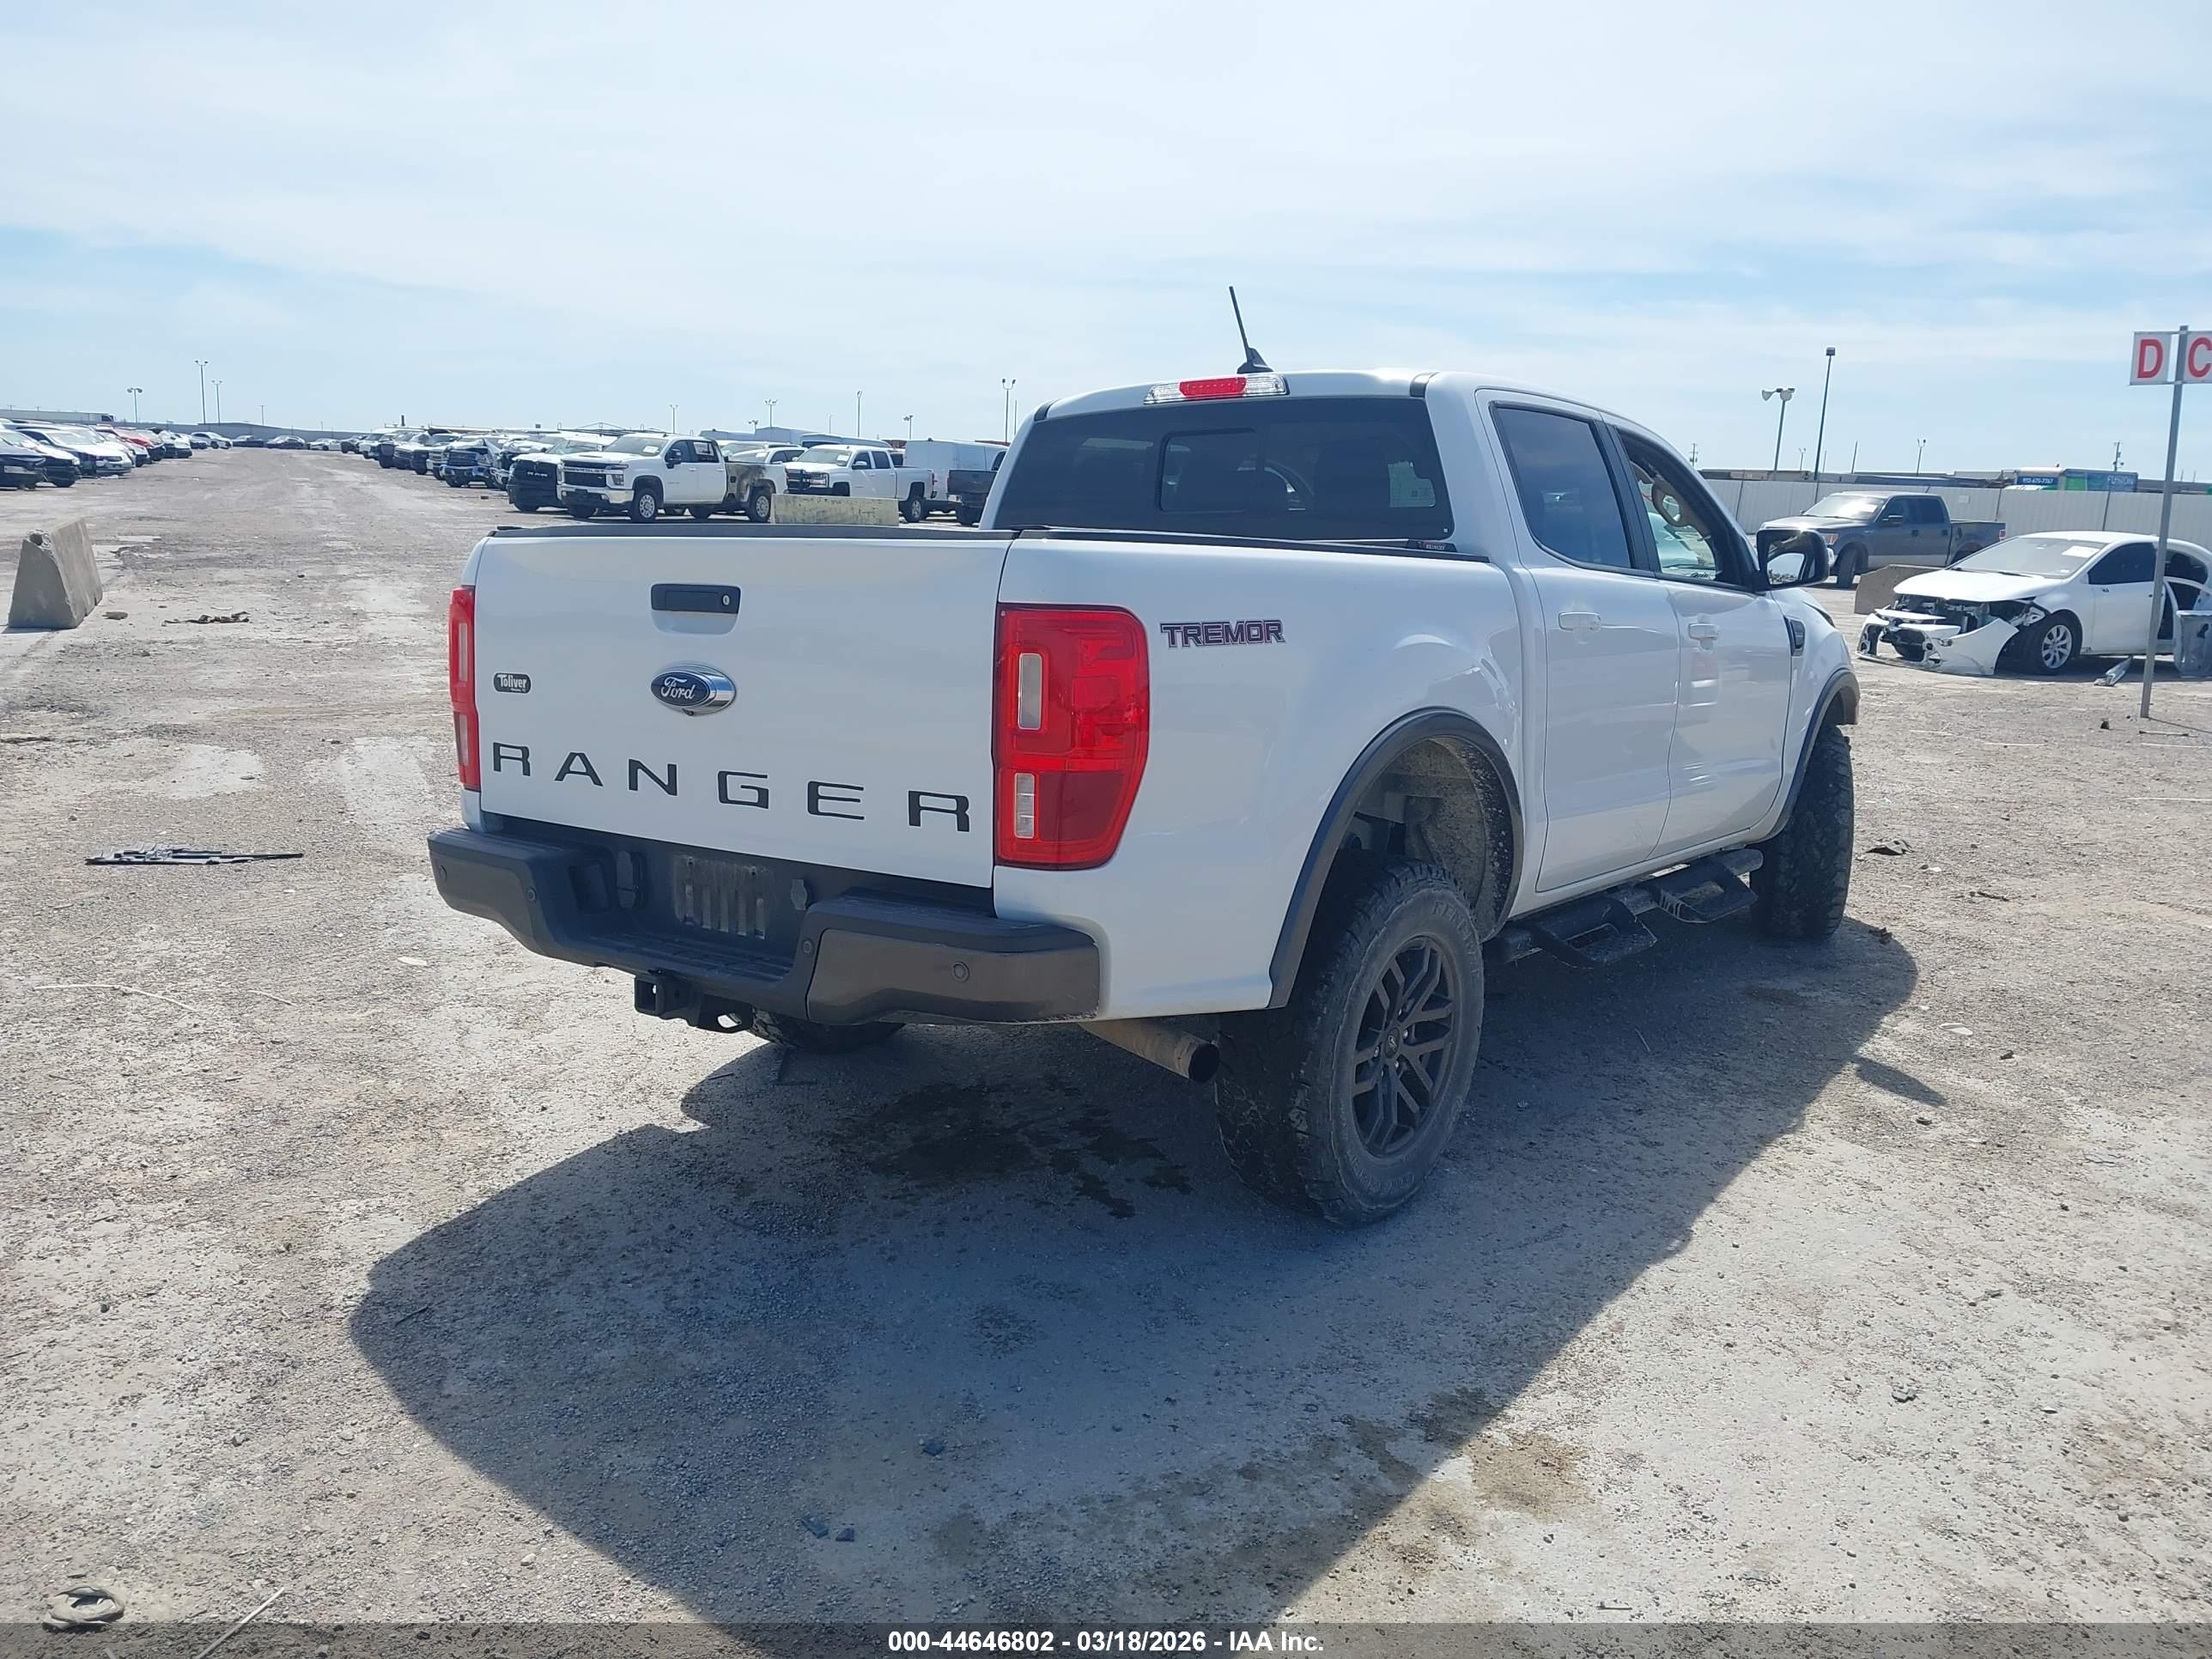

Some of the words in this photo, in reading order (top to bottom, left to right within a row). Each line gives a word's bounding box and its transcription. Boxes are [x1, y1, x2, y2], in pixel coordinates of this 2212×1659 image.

[2137, 338, 2163, 379] D
[2188, 337, 2212, 378] C
[1160, 620, 1285, 647] TREMOR
[496, 674, 527, 688] Toliver
[660, 676, 696, 699] Ford
[493, 742, 970, 832] RANGER
